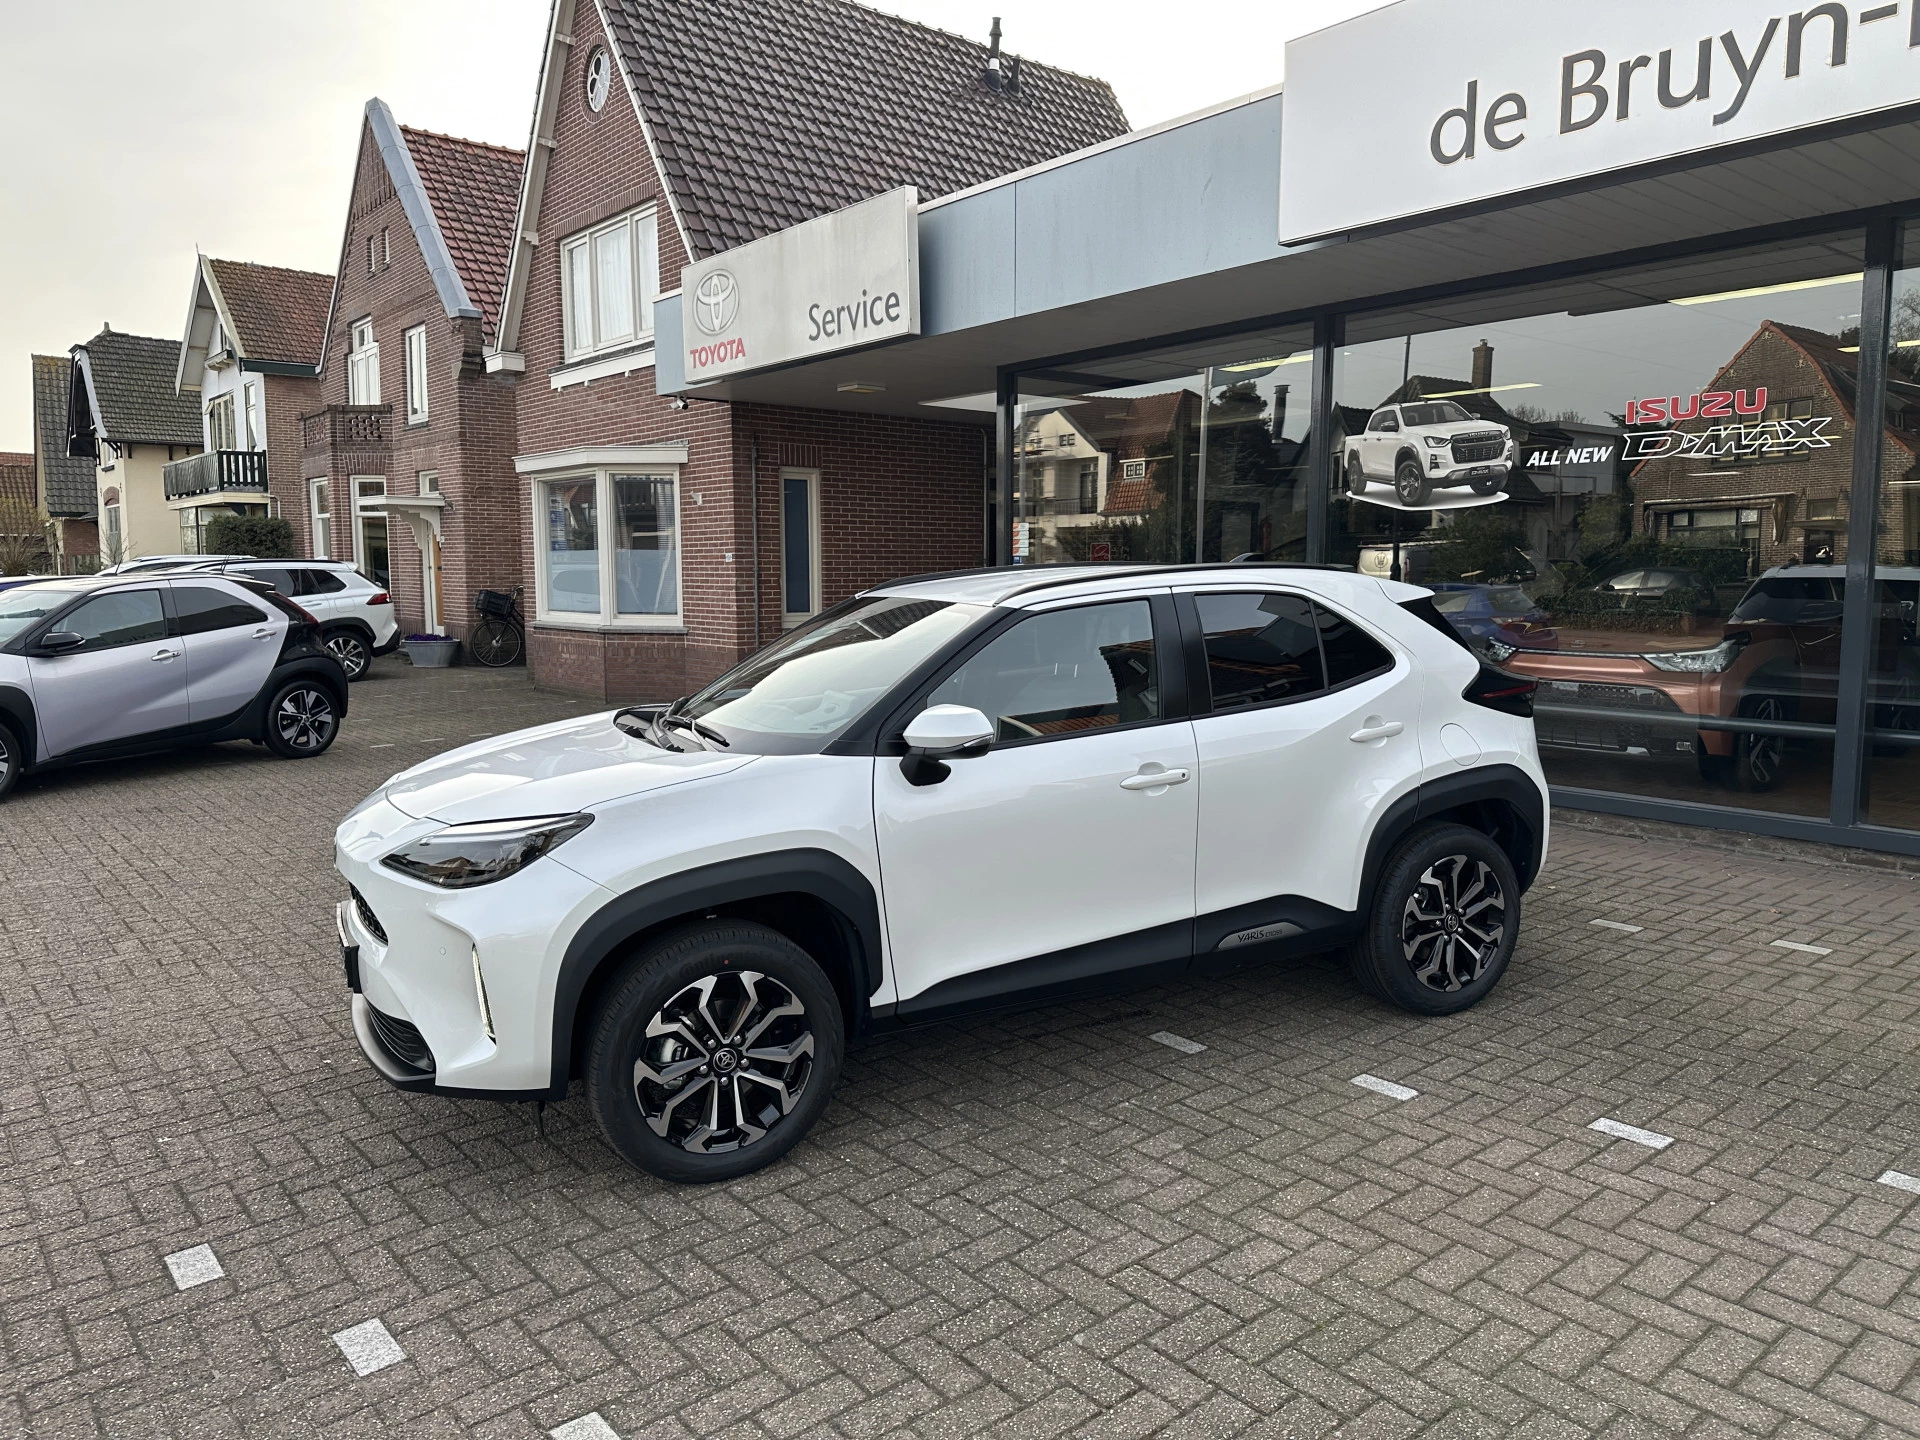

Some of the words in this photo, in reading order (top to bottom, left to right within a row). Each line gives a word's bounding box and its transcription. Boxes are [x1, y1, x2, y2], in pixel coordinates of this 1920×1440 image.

[1430, 80, 1528, 166] de
[1559, 0, 1920, 135] Bruyn-
[808, 289, 900, 341] Service
[690, 338, 746, 369] TOYOTA
[1625, 387, 1767, 425] ISUZU
[1526, 450, 1560, 467] ALL
[1565, 446, 1613, 464] NEW
[1621, 417, 1833, 461] D-MAX
